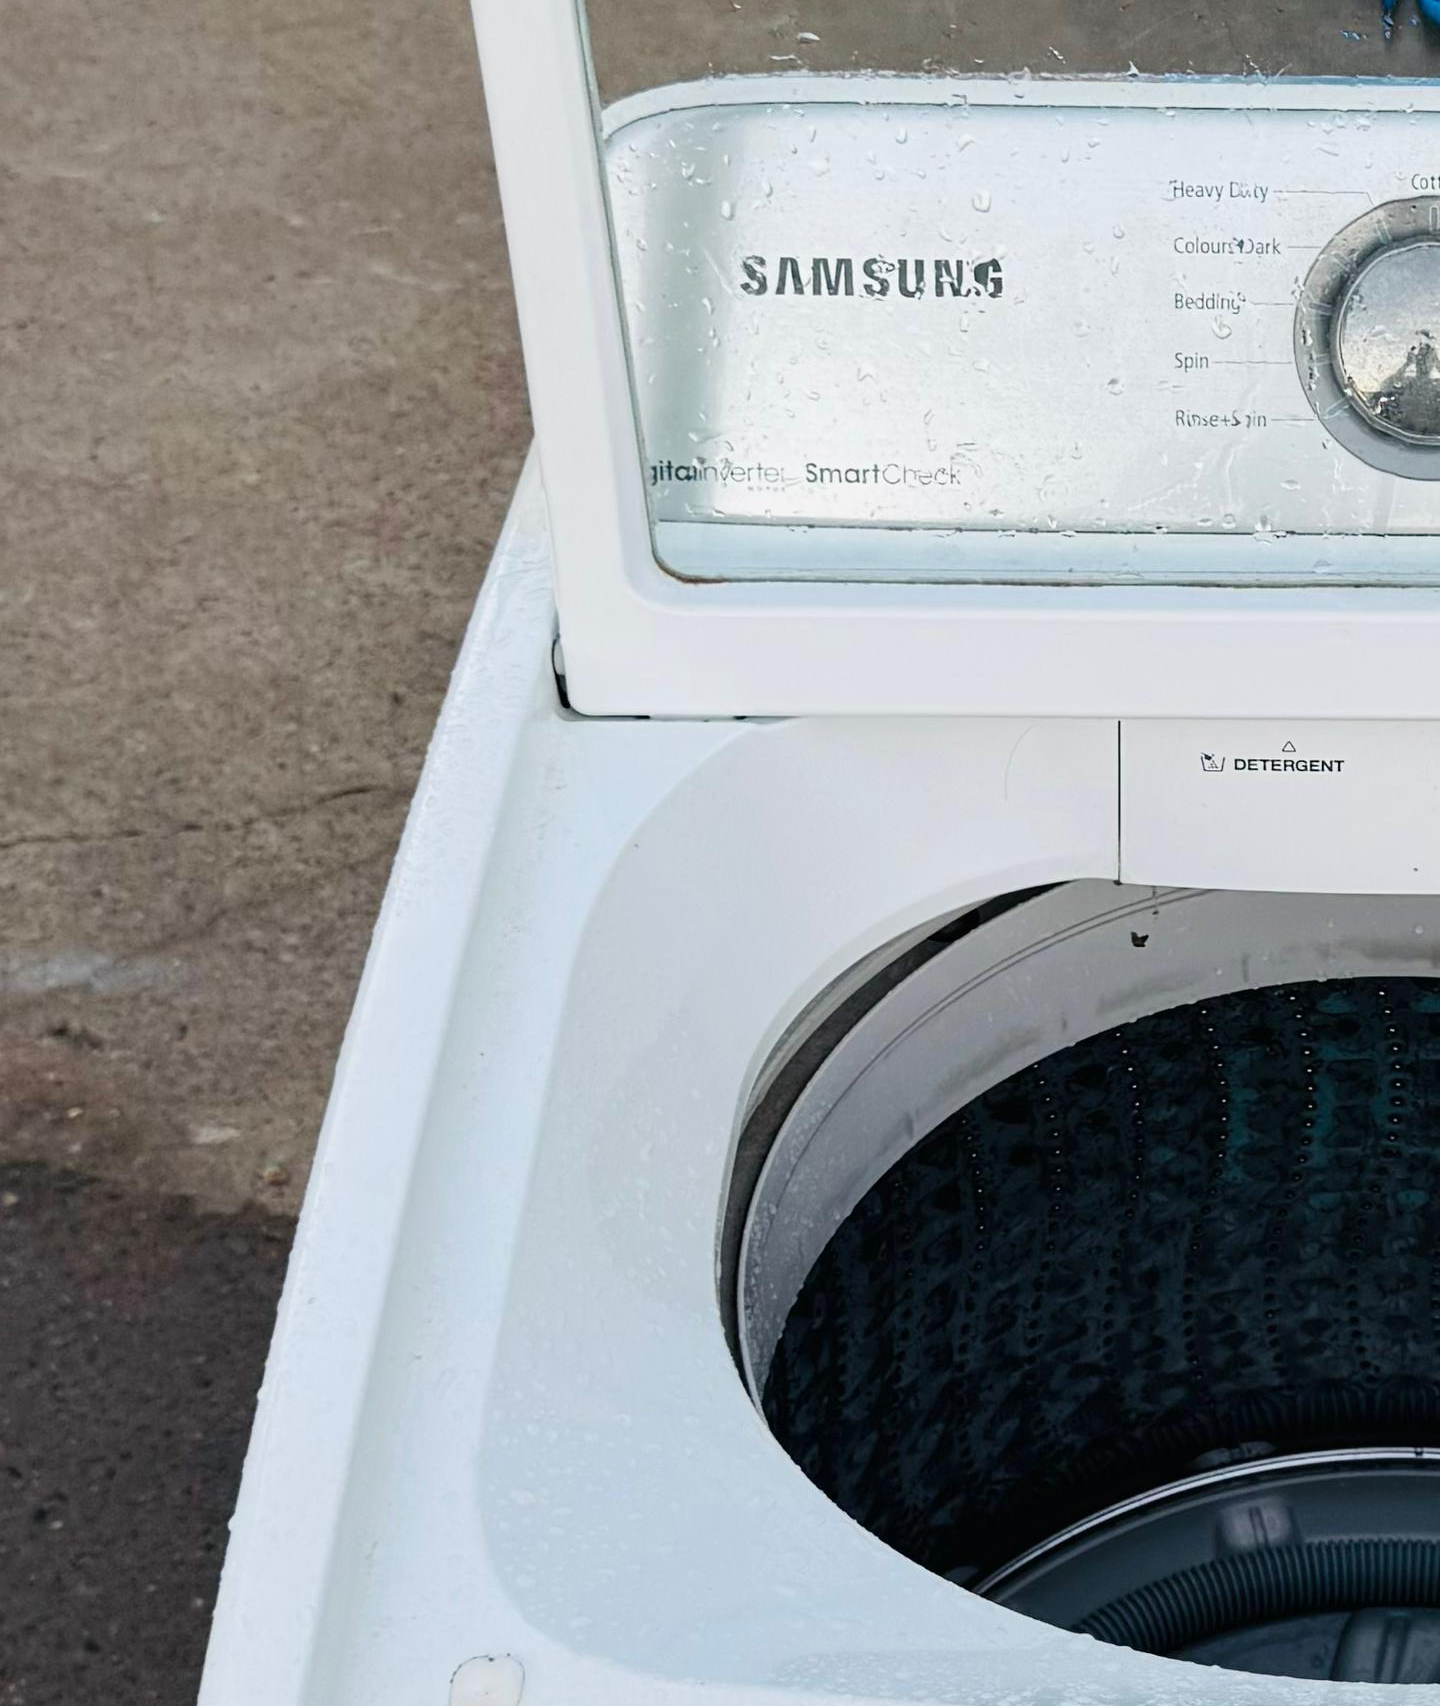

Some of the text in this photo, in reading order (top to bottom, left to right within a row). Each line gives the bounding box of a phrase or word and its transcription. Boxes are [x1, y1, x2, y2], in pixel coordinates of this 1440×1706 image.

[1173, 180, 1224, 202] Heavy
[740, 255, 1003, 298] SAMSUNG
[1174, 293, 1242, 314] Bedding
[1174, 352, 1210, 373] Spin
[1234, 758, 1345, 773] DETERGENT
